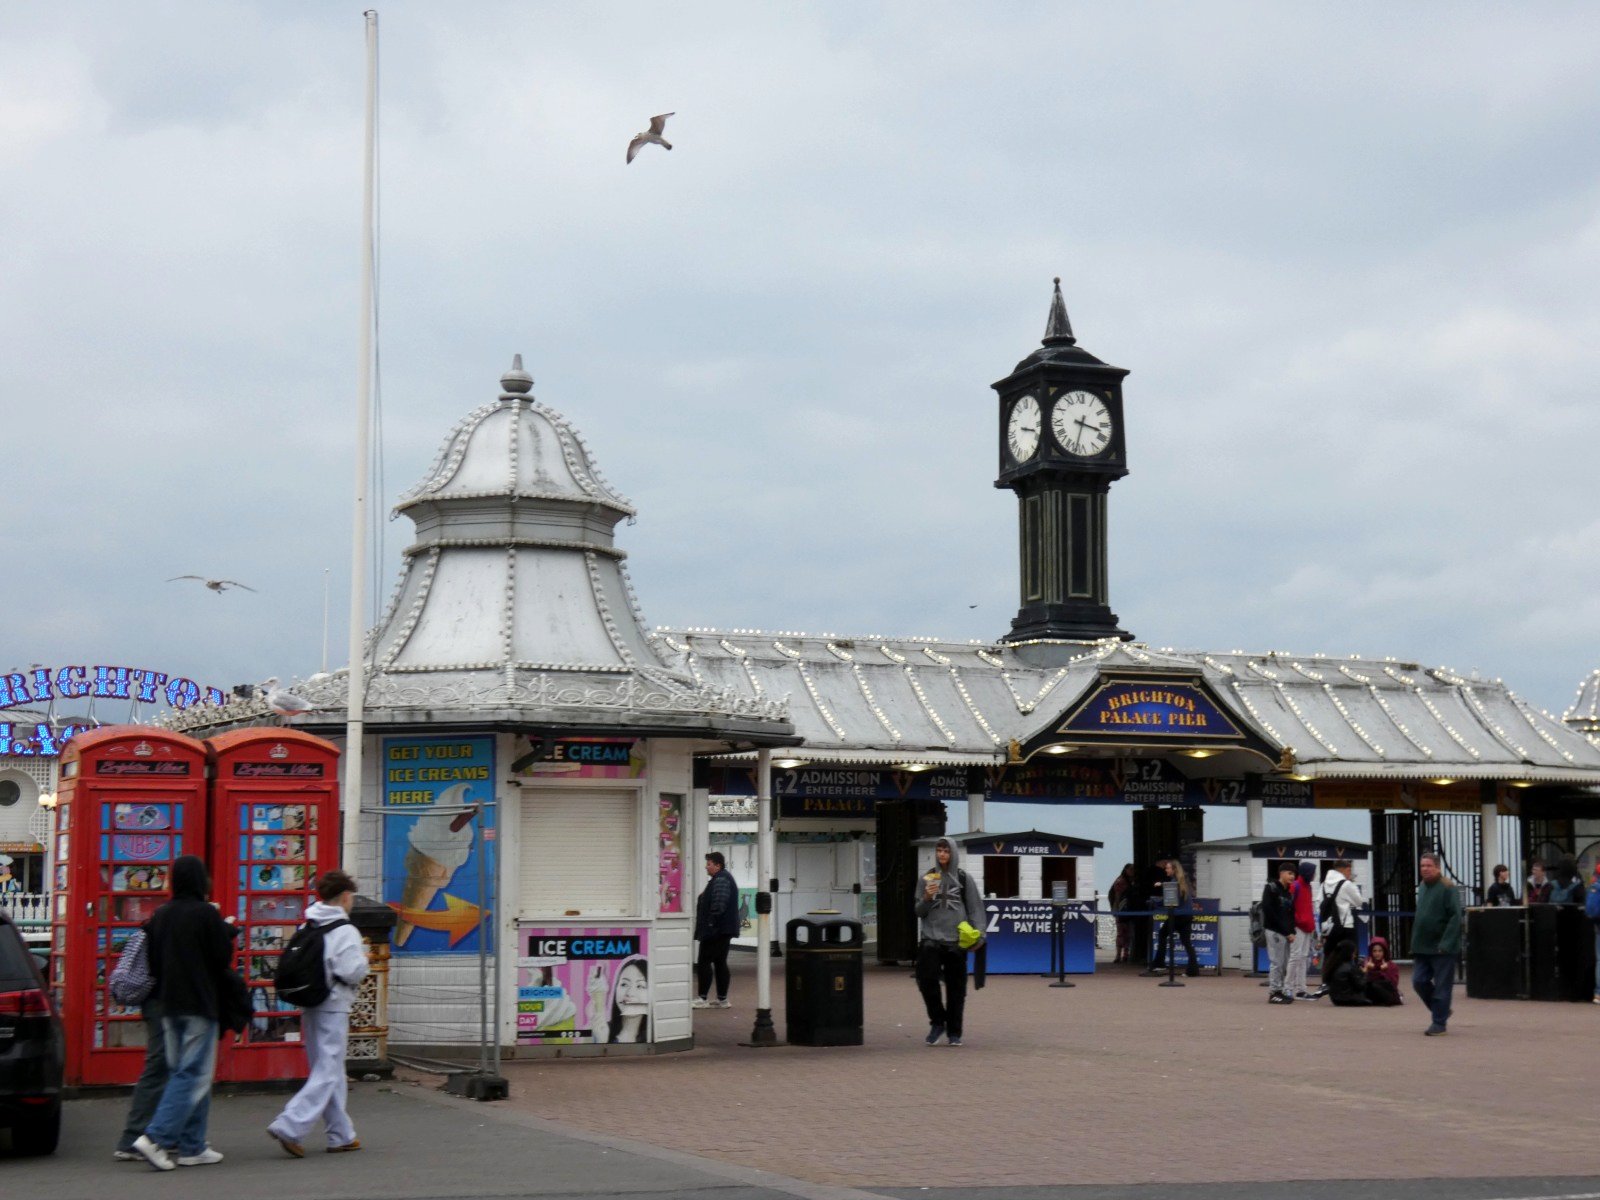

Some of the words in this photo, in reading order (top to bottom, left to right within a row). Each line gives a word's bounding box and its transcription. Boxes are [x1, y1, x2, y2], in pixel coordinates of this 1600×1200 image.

[1109, 691, 1195, 712] BRIGHTON
[1100, 711, 1161, 725] PALACE
[1168, 713, 1207, 726] PIER
[389, 747, 419, 761] GET
[424, 745, 473, 759] YOUR
[568, 745, 628, 761] CREAM
[389, 769, 415, 783] ICE
[418, 766, 490, 781] CREAMS
[1142, 760, 1162, 781] £2
[775, 769, 799, 795] £2
[800, 771, 881, 786] ADMISSION
[1124, 782, 1185, 793] ADMISSION
[389, 790, 435, 805] HERE
[805, 786, 838, 796] ENTER
[845, 787, 876, 796] HERE
[929, 789, 963, 798] ENTER
[1220, 781, 1241, 804] £2
[1124, 794, 1154, 803] ENTER
[1157, 794, 1185, 803] HERE
[1013, 845, 1028, 854] PAY
[1028, 846, 1050, 855] HERE
[1294, 850, 1308, 858] PAY
[1308, 850, 1327, 858] HERE
[1014, 921, 1032, 933] PAY
[539, 940, 567, 956] ICE
[570, 940, 632, 956] CREAM
[519, 988, 562, 998] BRIGHTON
[519, 1002, 543, 1011] YOUR
[519, 1015, 536, 1025] DAY
